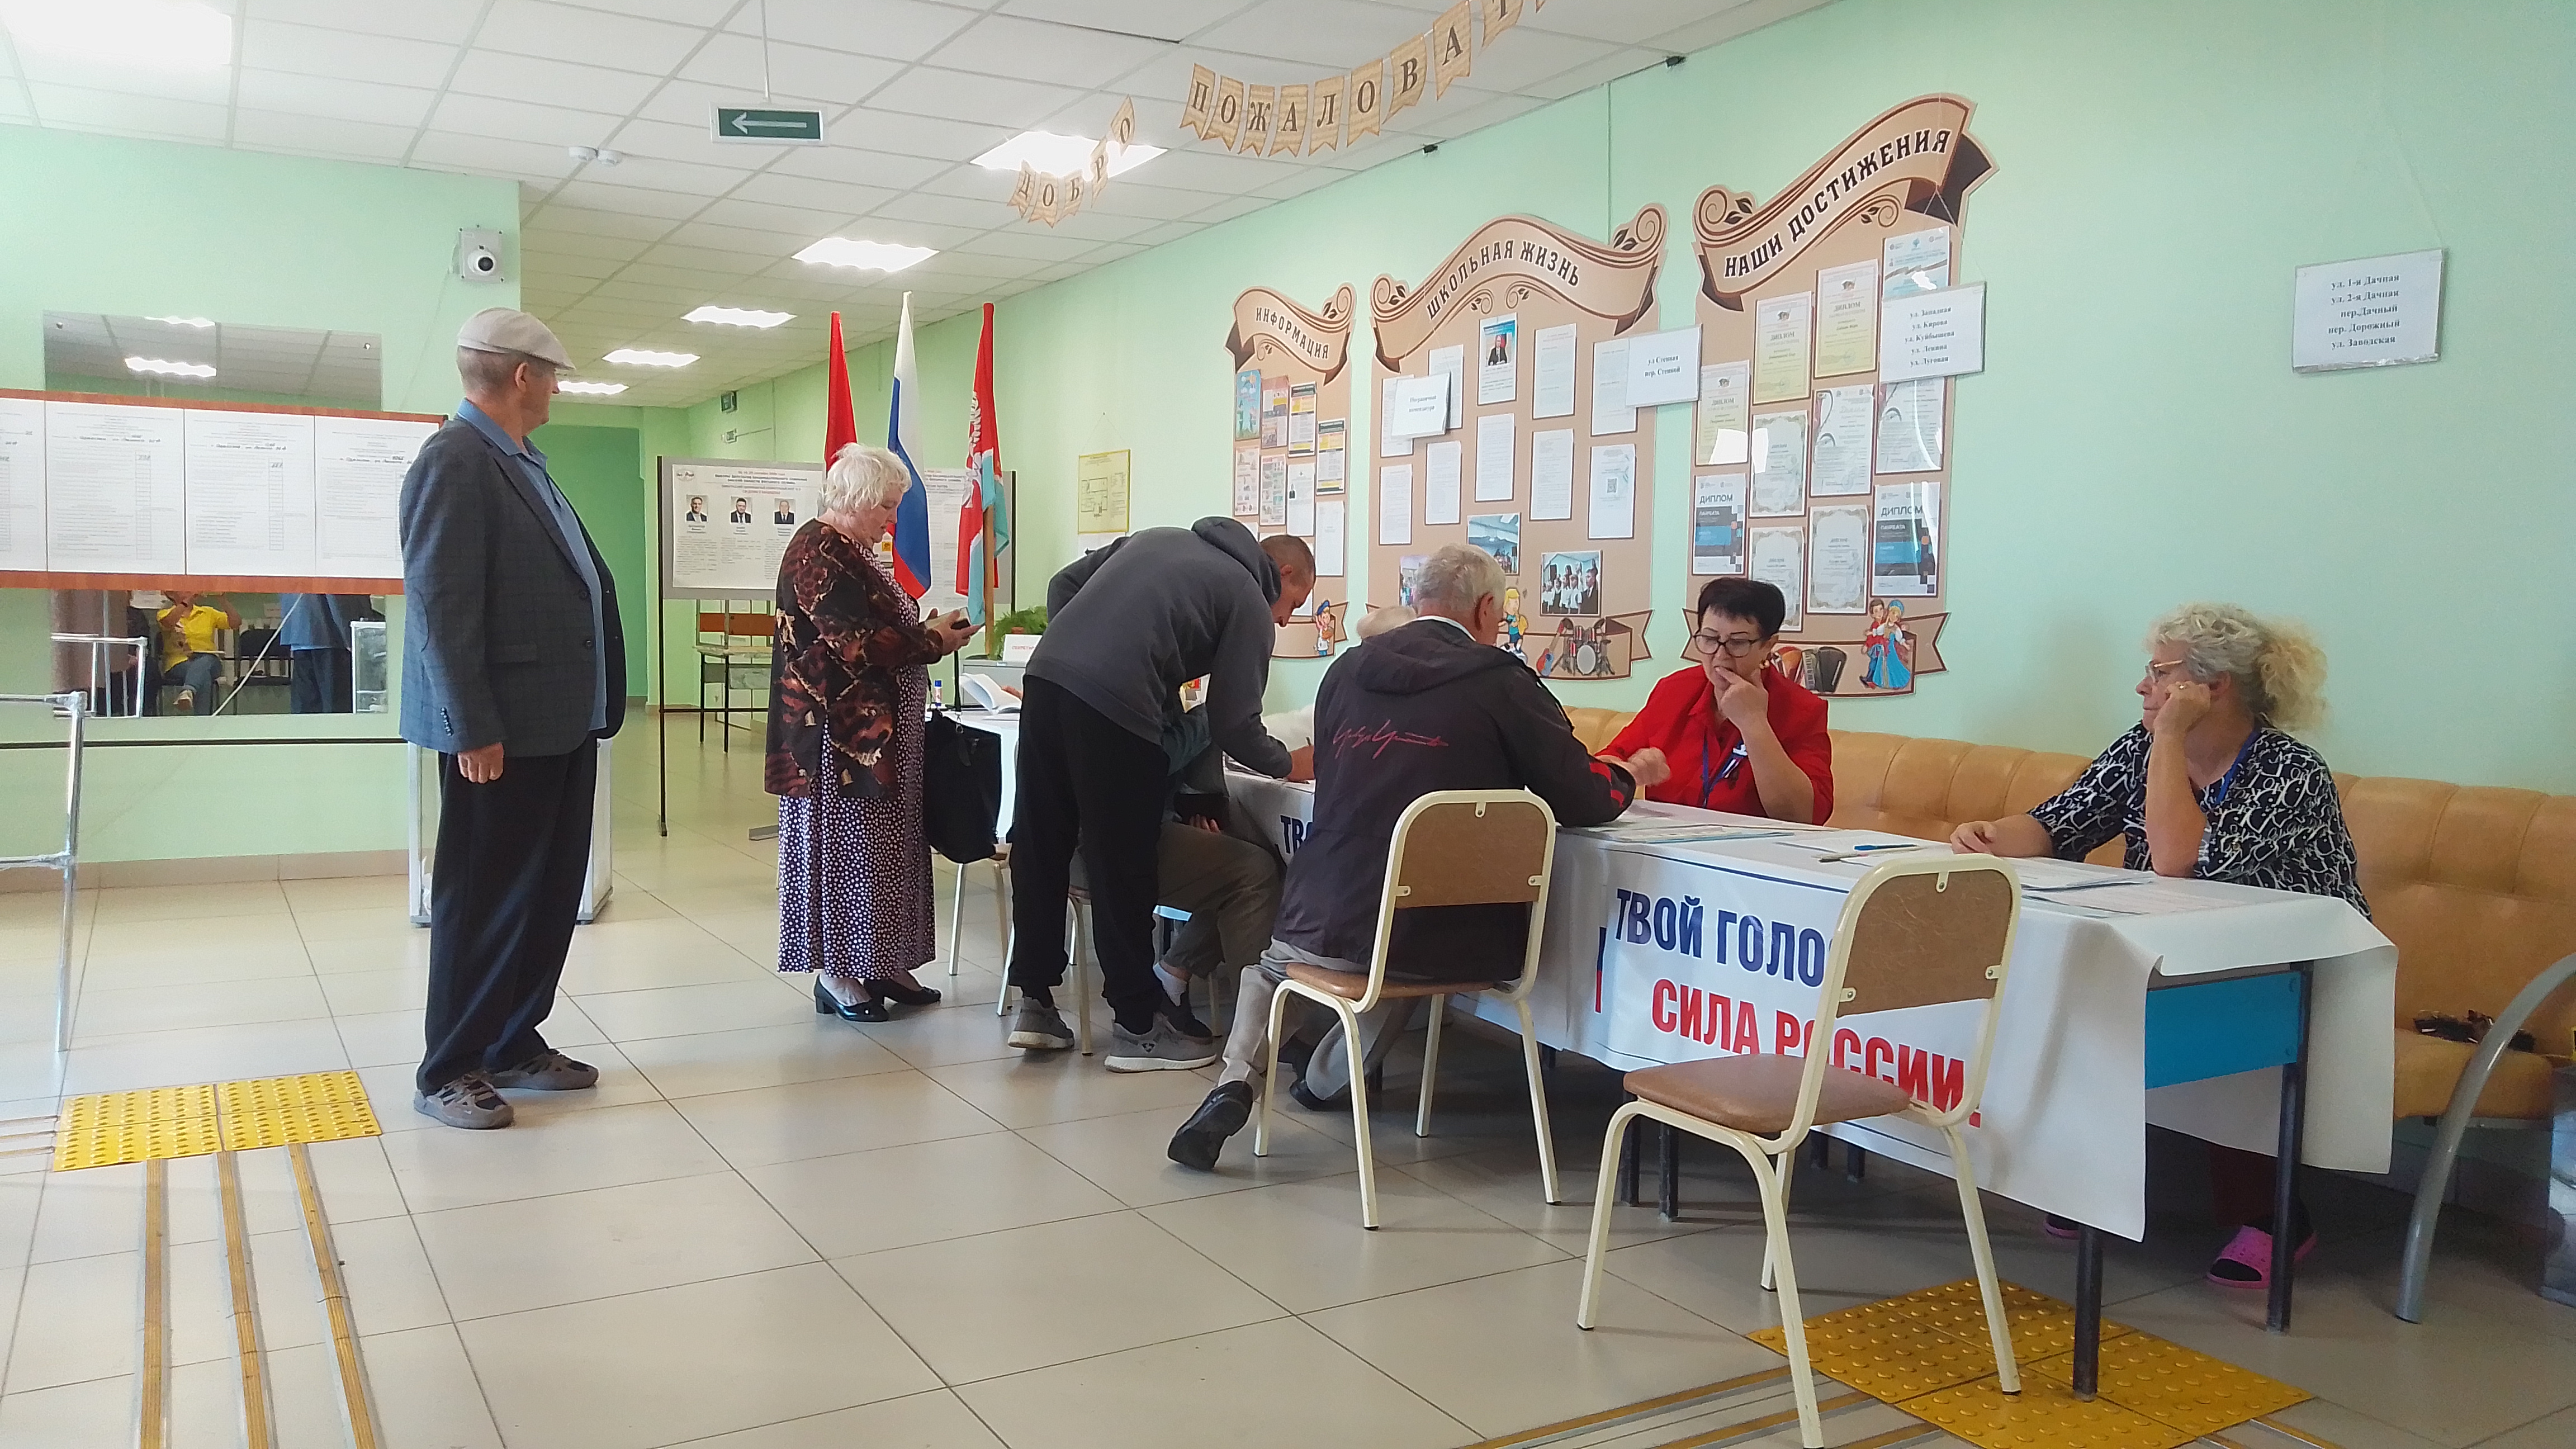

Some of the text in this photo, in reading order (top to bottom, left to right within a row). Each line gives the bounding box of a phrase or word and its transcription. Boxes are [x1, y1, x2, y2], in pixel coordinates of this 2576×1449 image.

[1018, 0, 1508, 207] ДОБРО ПОЖАЛОВАТ
[1725, 129, 1951, 277] НАШИ ДОСТИЖЕНИЯ
[1427, 240, 1580, 319] ШКОЛЬНАЯ ЖИЗНЬ
[2331, 274, 2399, 291] ул. 1-я Дачная
[2331, 290, 2399, 305] ул. 2-я Дачная
[1924, 319, 1948, 329] Кирова
[2349, 319, 2400, 333] Дорожный
[1256, 307, 1329, 359] ИНФОРМАЦИЯ
[2331, 335, 2396, 351] ул. Заводская
[1921, 356, 1949, 366] Луговая
[1699, 494, 1733, 505] ДИПЛОМ
[1616, 888, 1832, 988] ТВОЙ ГОЛО
[1652, 978, 1760, 1055] СИЛА
